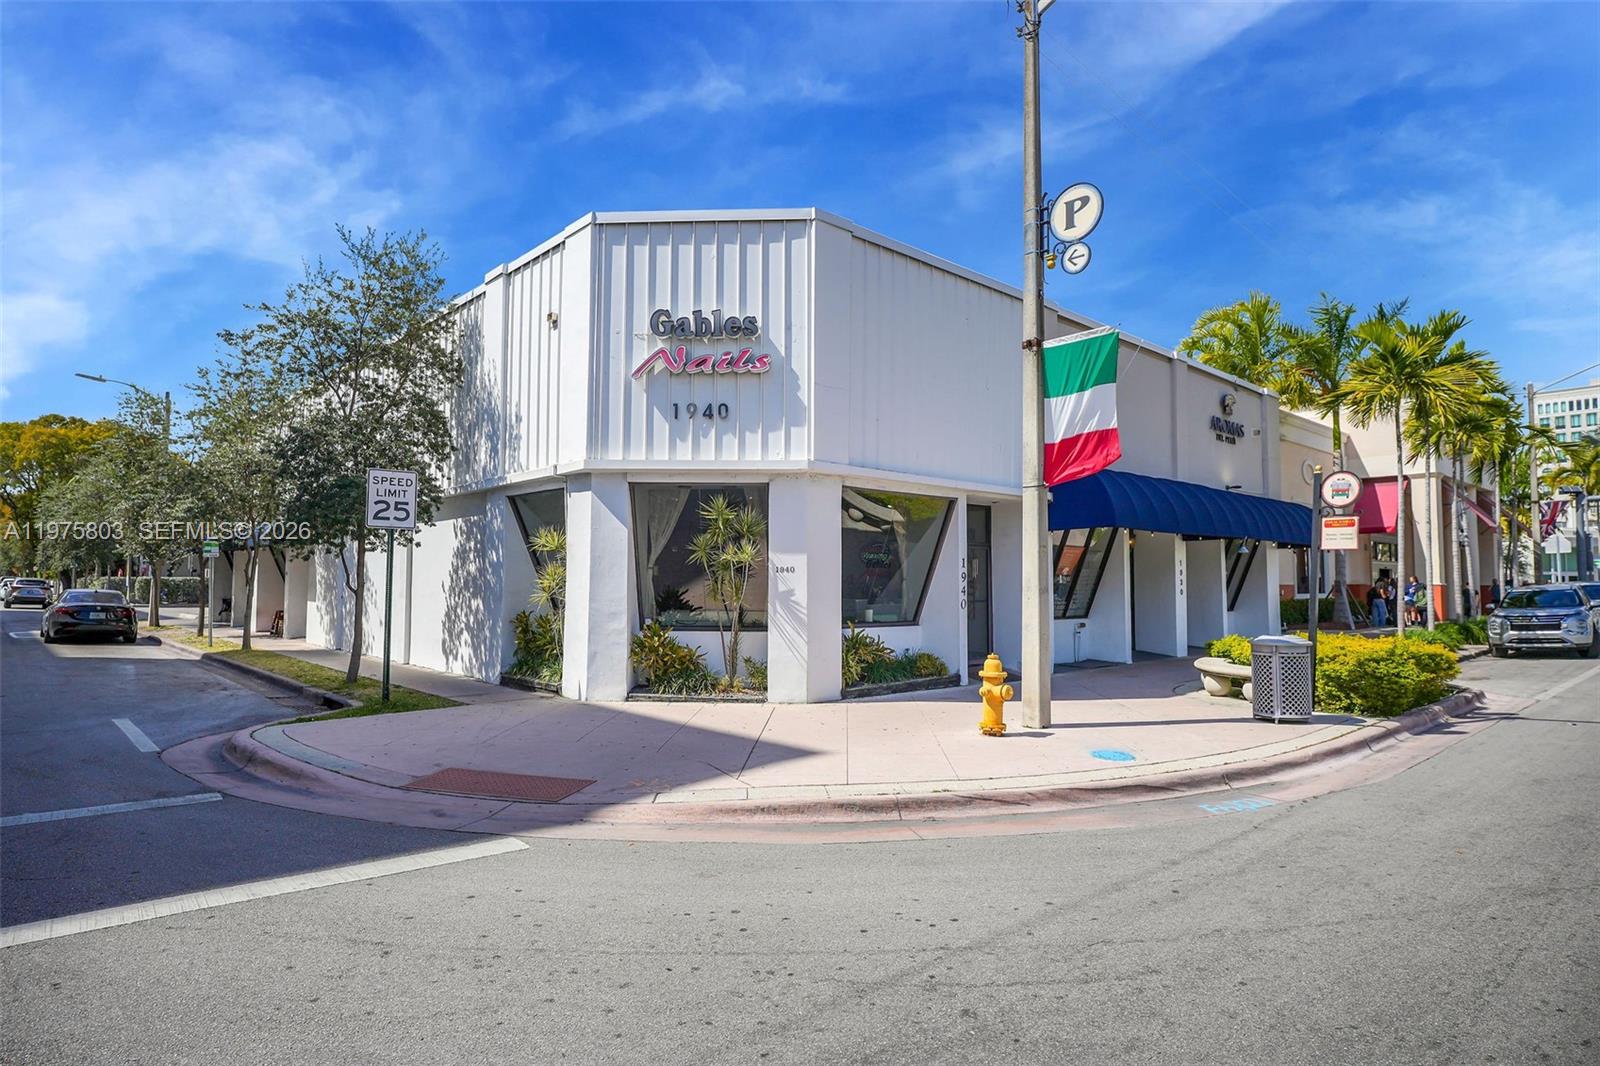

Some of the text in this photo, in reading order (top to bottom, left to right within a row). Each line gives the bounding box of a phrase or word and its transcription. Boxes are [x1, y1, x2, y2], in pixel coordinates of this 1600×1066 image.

[1063, 195, 1090, 231] P
[650, 309, 760, 338] Gables
[631, 346, 772, 380] Nails
[672, 403, 729, 420] 1940
[1210, 415, 1245, 438] AROMAS
[372, 476, 413, 487] SPEED
[376, 488, 408, 498] LIMIT
[372, 500, 410, 522] 25
